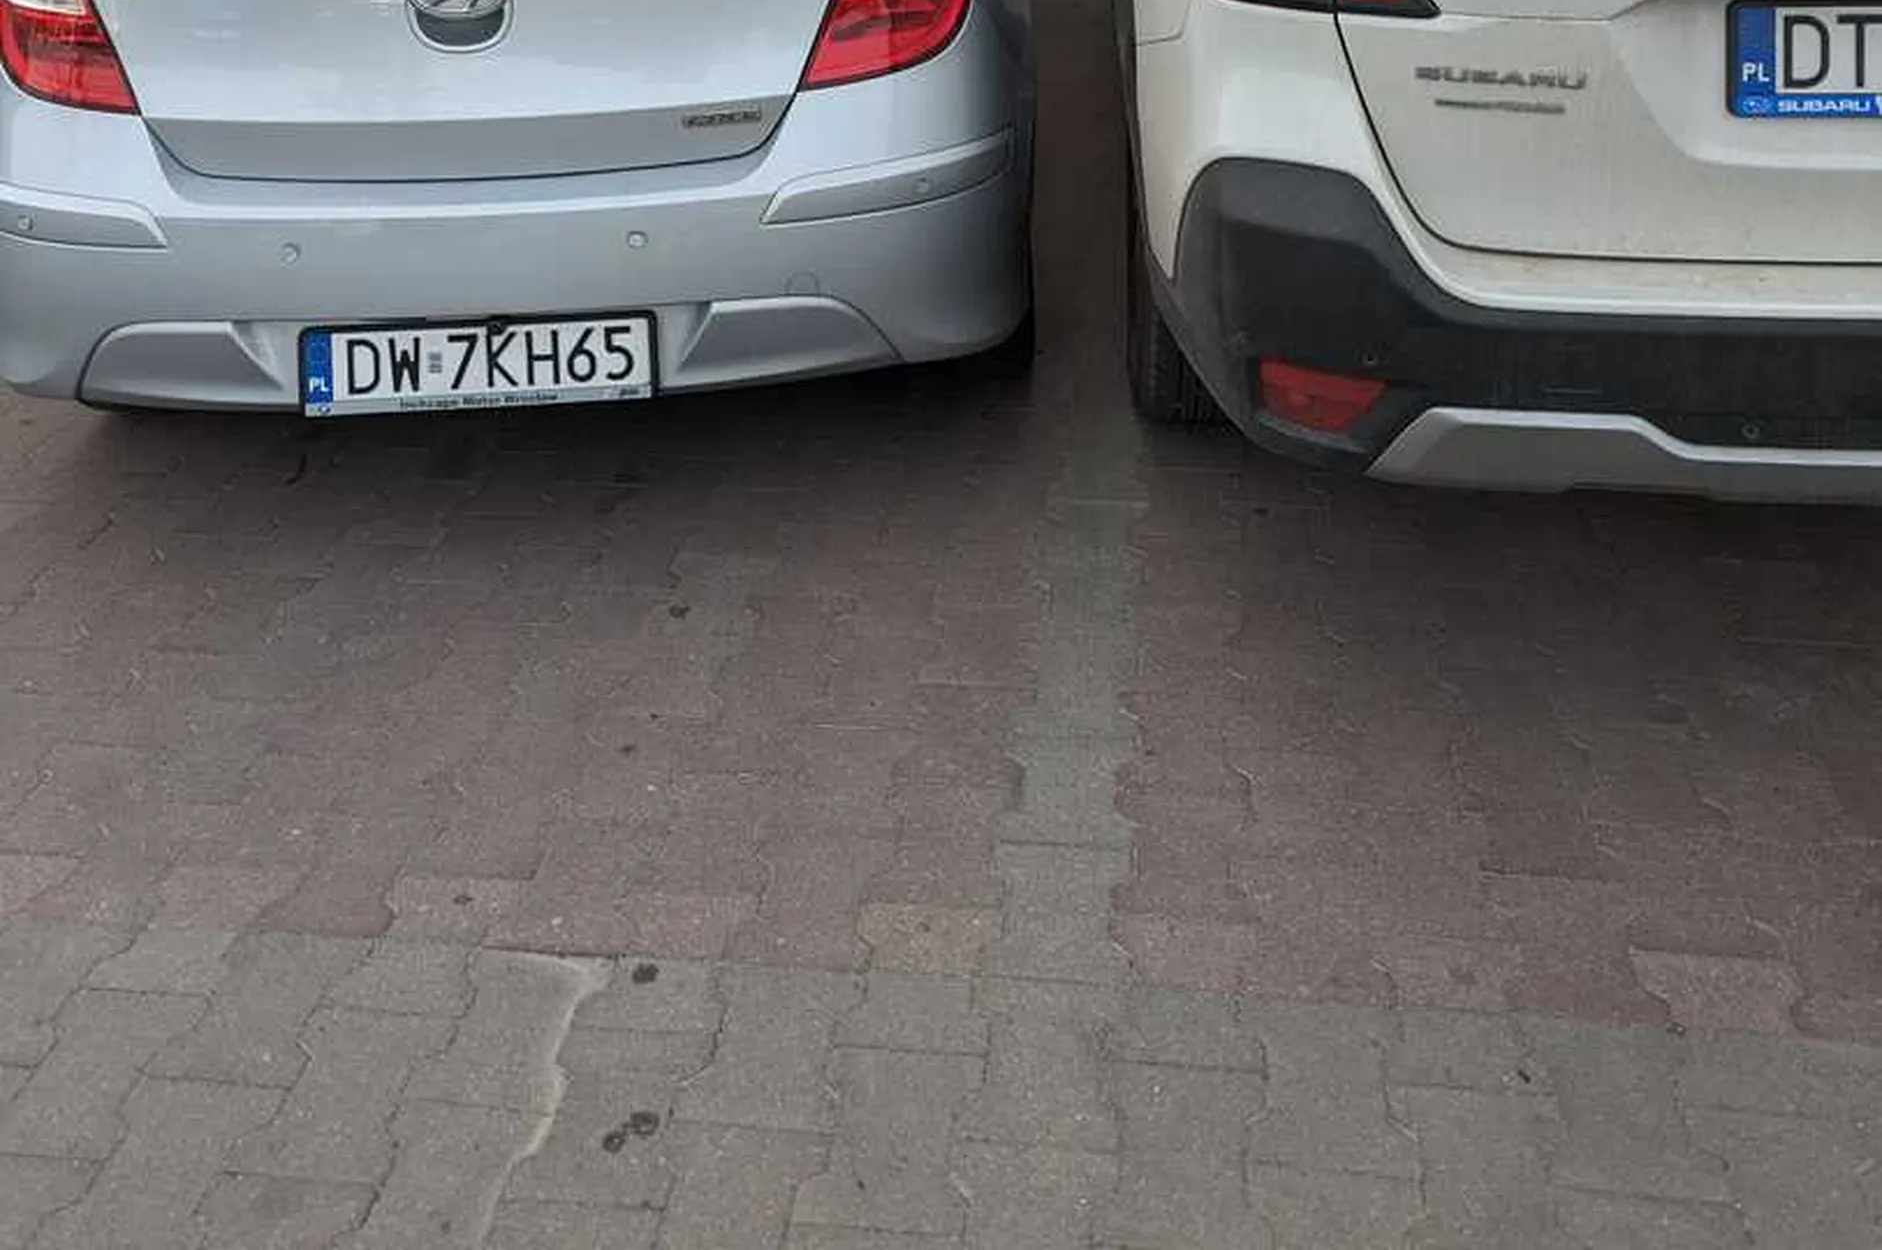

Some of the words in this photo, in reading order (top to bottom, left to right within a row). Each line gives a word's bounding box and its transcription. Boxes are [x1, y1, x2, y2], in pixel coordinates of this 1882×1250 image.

[1415, 65, 1588, 90] SUBARU
[1742, 62, 1770, 82] PL
[1777, 98, 1871, 113] SUBARU
[346, 336, 421, 395] DW
[447, 325, 634, 391] 7KH65
[309, 377, 330, 393] PL
